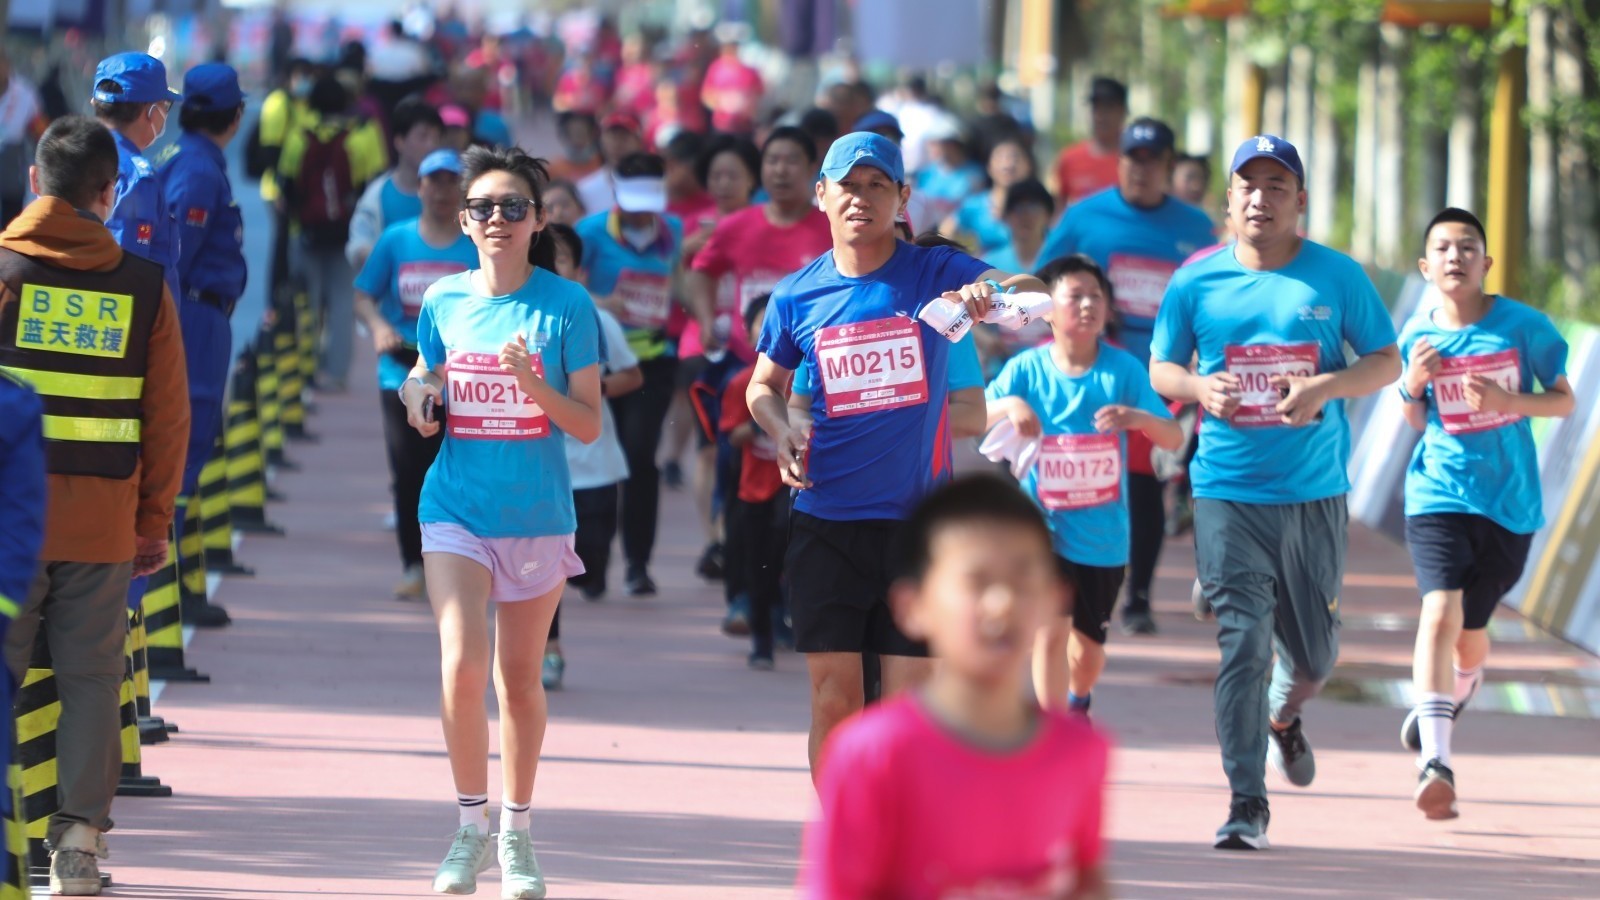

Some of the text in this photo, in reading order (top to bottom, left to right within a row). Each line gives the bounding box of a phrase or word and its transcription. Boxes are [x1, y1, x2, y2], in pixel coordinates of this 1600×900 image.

[20, 317, 124, 353] 蓝天救援
[826, 346, 915, 380] M0215
[1044, 457, 1114, 479] M0172
